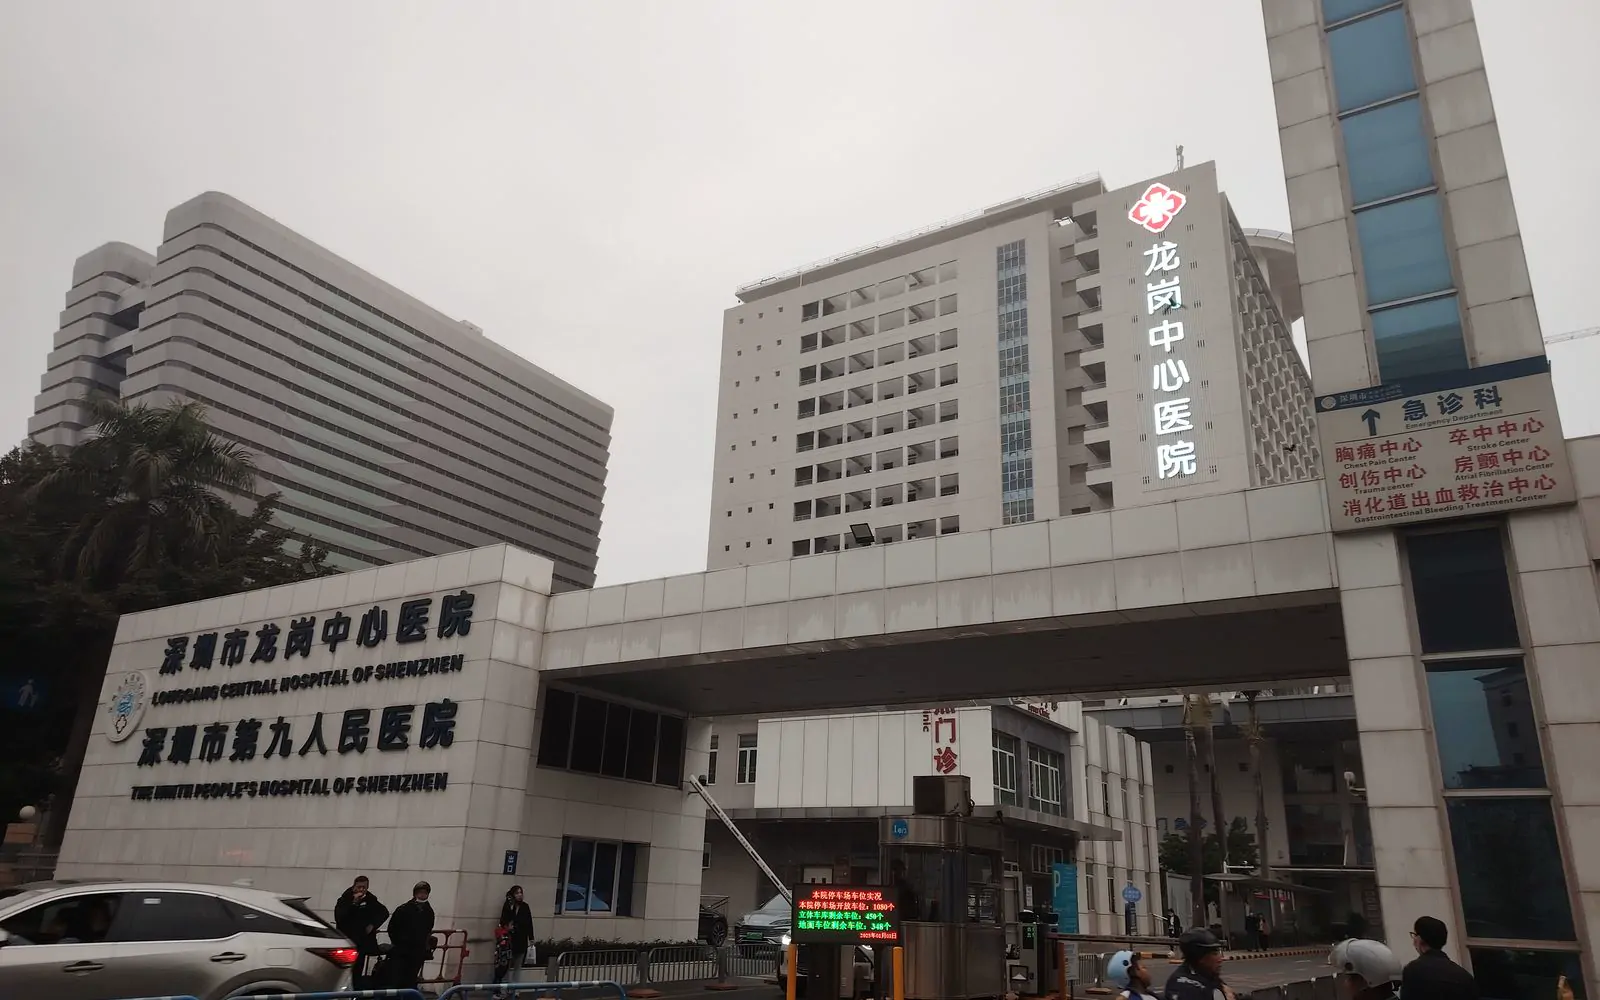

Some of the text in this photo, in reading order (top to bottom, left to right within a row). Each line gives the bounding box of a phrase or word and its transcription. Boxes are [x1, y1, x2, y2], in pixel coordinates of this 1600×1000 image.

[1144, 241, 1197, 480] 龙岗中心医院
[1402, 385, 1502, 421] 急诊科
[1406, 409, 1503, 430] Emergency Department
[1448, 417, 1544, 445] 卒中中心
[1335, 437, 1422, 463] 胸痛中心
[1467, 438, 1530, 452] Stroke Center
[1344, 462, 1367, 470] Chest
[1389, 455, 1416, 464] Center
[1454, 445, 1550, 474] 房颤中心
[1480, 468, 1524, 477] Fibrillation
[1525, 463, 1554, 472] Center
[1338, 463, 1427, 489] 创伤中心
[1342, 474, 1556, 517] 消化道出血救治中心
[1354, 487, 1385, 495] Trauma
[1354, 494, 1547, 523] Gastrointestinal Bleeding Treatment Center
[160, 590, 474, 675] 深圳市龙岗中心医院
[152, 685, 219, 706] LONGGANG
[220, 679, 278, 698] CENTRAL
[280, 669, 349, 692] HOSPITAL
[352, 665, 373, 683] OF
[374, 654, 464, 681] SHENZHEN
[137, 698, 458, 766] 深圳市第九人民医院
[131, 786, 154, 800] THE
[194, 781, 257, 798] PEOPLE'S
[259, 779, 330, 797] HOSPITAL
[333, 777, 355, 793] OF
[356, 772, 448, 793] SHENZHEN
[812, 890, 882, 900] 本院停车场车位实况
